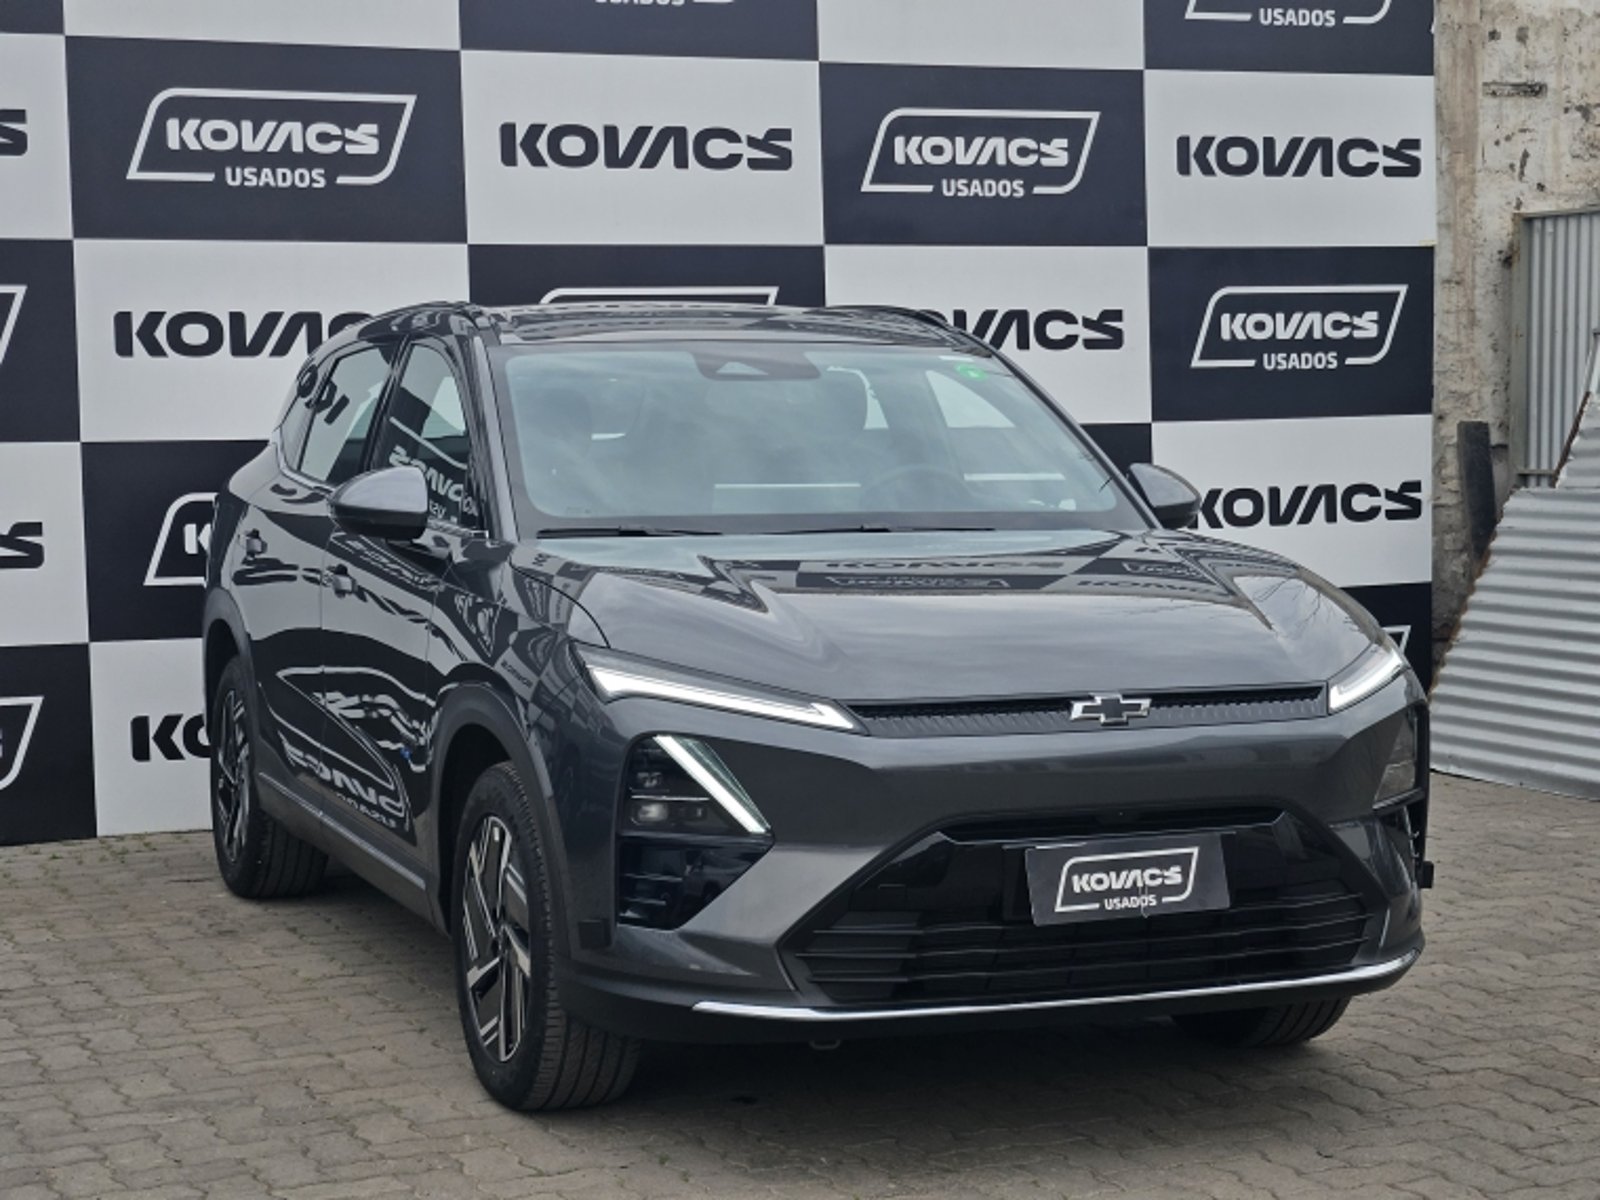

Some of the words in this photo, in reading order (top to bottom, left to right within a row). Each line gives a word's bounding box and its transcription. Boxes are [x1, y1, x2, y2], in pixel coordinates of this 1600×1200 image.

[1259, 7, 1336, 27] USADOS
[166, 117, 380, 155] KOVACS
[499, 122, 793, 171] KOVACS
[894, 135, 1069, 167] KOVACS
[1176, 135, 1422, 178] KOVACS
[225, 166, 326, 188] USADOS
[941, 178, 1025, 198] USADOS
[113, 310, 373, 358] KOVA
[918, 308, 1124, 351] VACS
[1220, 310, 1379, 341] KOVACS
[1262, 351, 1338, 371] USADOS
[1187, 479, 1422, 529] KOVACS
[1071, 865, 1183, 893] KOVACS
[1104, 894, 1158, 911] USADOS
